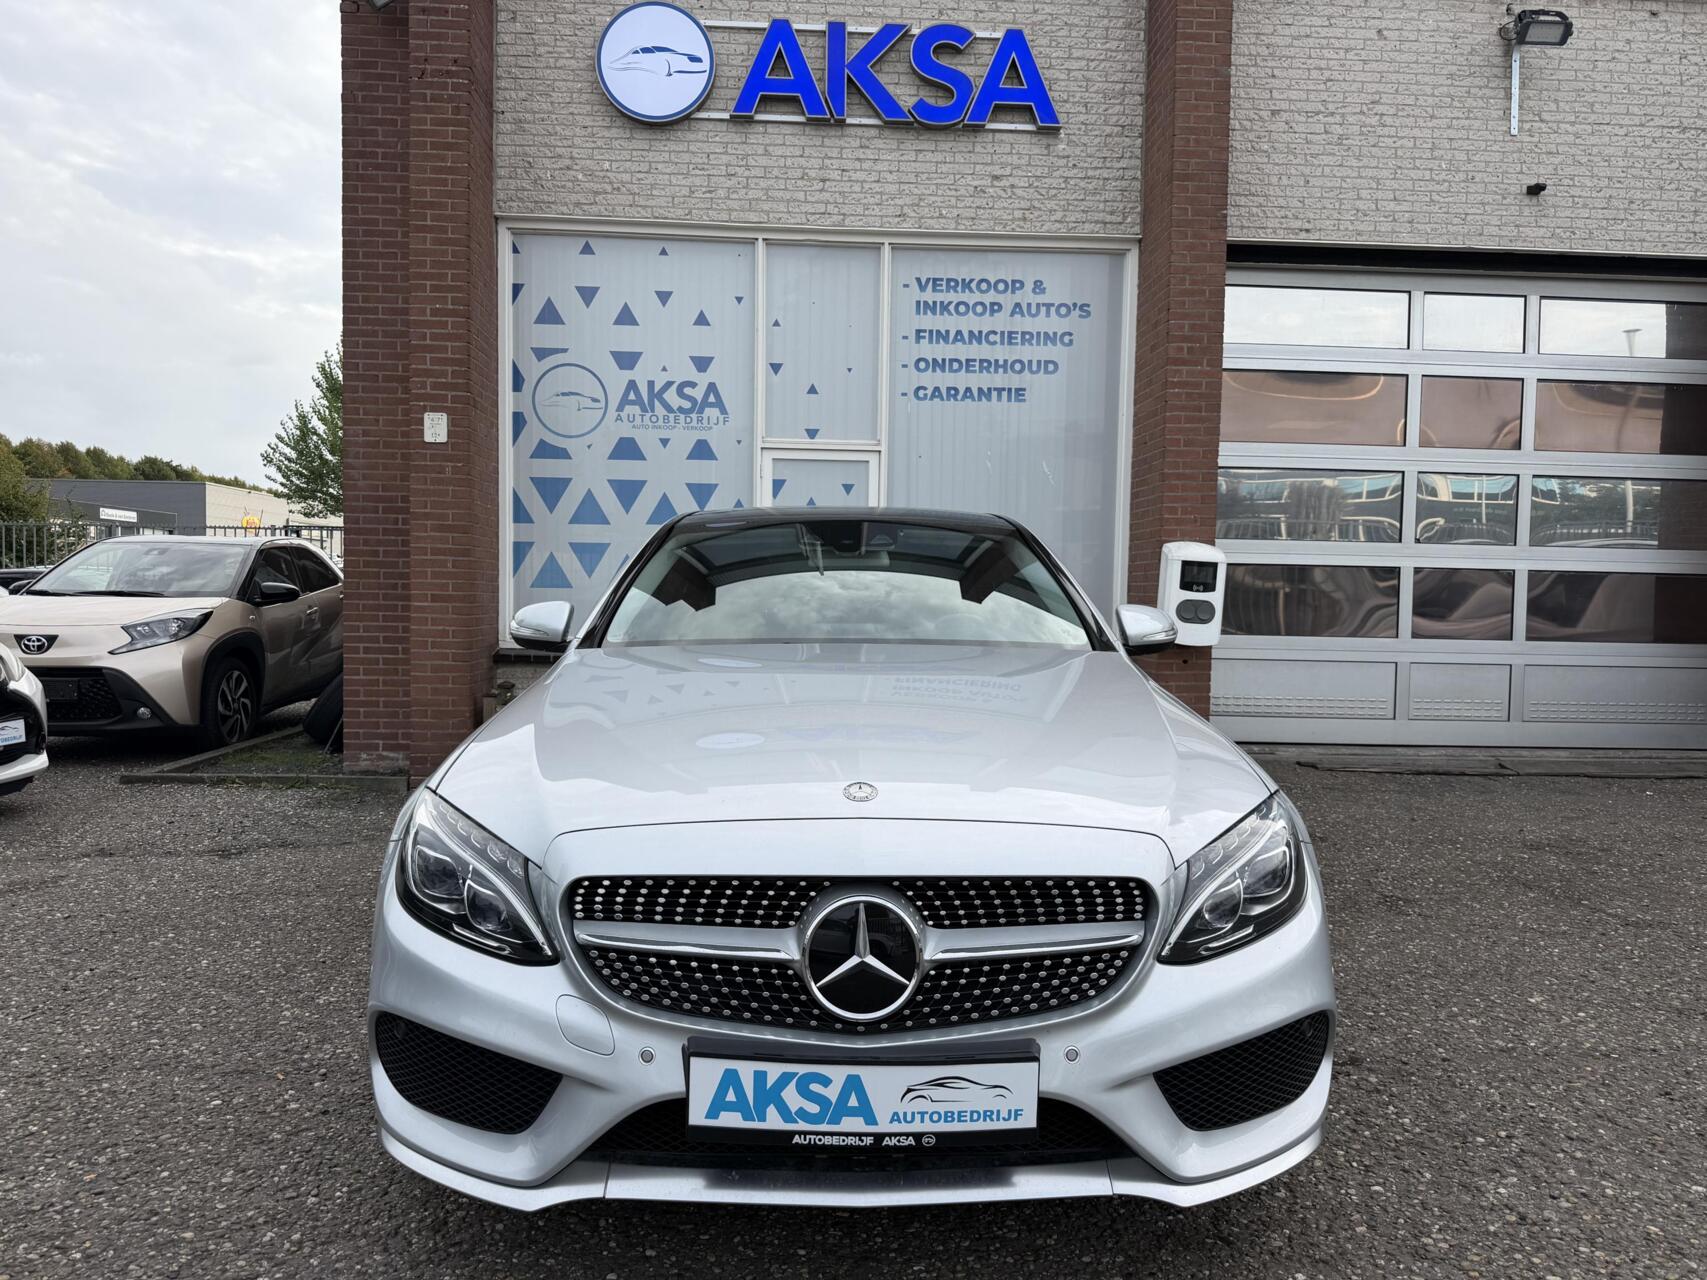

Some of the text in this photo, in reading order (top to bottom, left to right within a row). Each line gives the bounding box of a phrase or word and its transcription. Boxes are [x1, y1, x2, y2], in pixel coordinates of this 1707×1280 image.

[730, 18, 1061, 131] AKSA
[915, 277, 1025, 295] VERKOOP
[1032, 279, 1047, 295] &
[915, 300, 1003, 317] INKOOP
[914, 329, 1074, 347] FINANCIERING
[914, 357, 1059, 375] ONDERHOUD
[615, 379, 728, 415] AKSA
[913, 385, 1027, 403] GARANTIE
[615, 413, 729, 425] AUTOBEDRIJF
[704, 1068, 878, 1125] AKSA
[889, 1108, 1024, 1125] AUTOBEDRIJF
[792, 1134, 916, 1146] AUTOBEDRIJF AKSA
